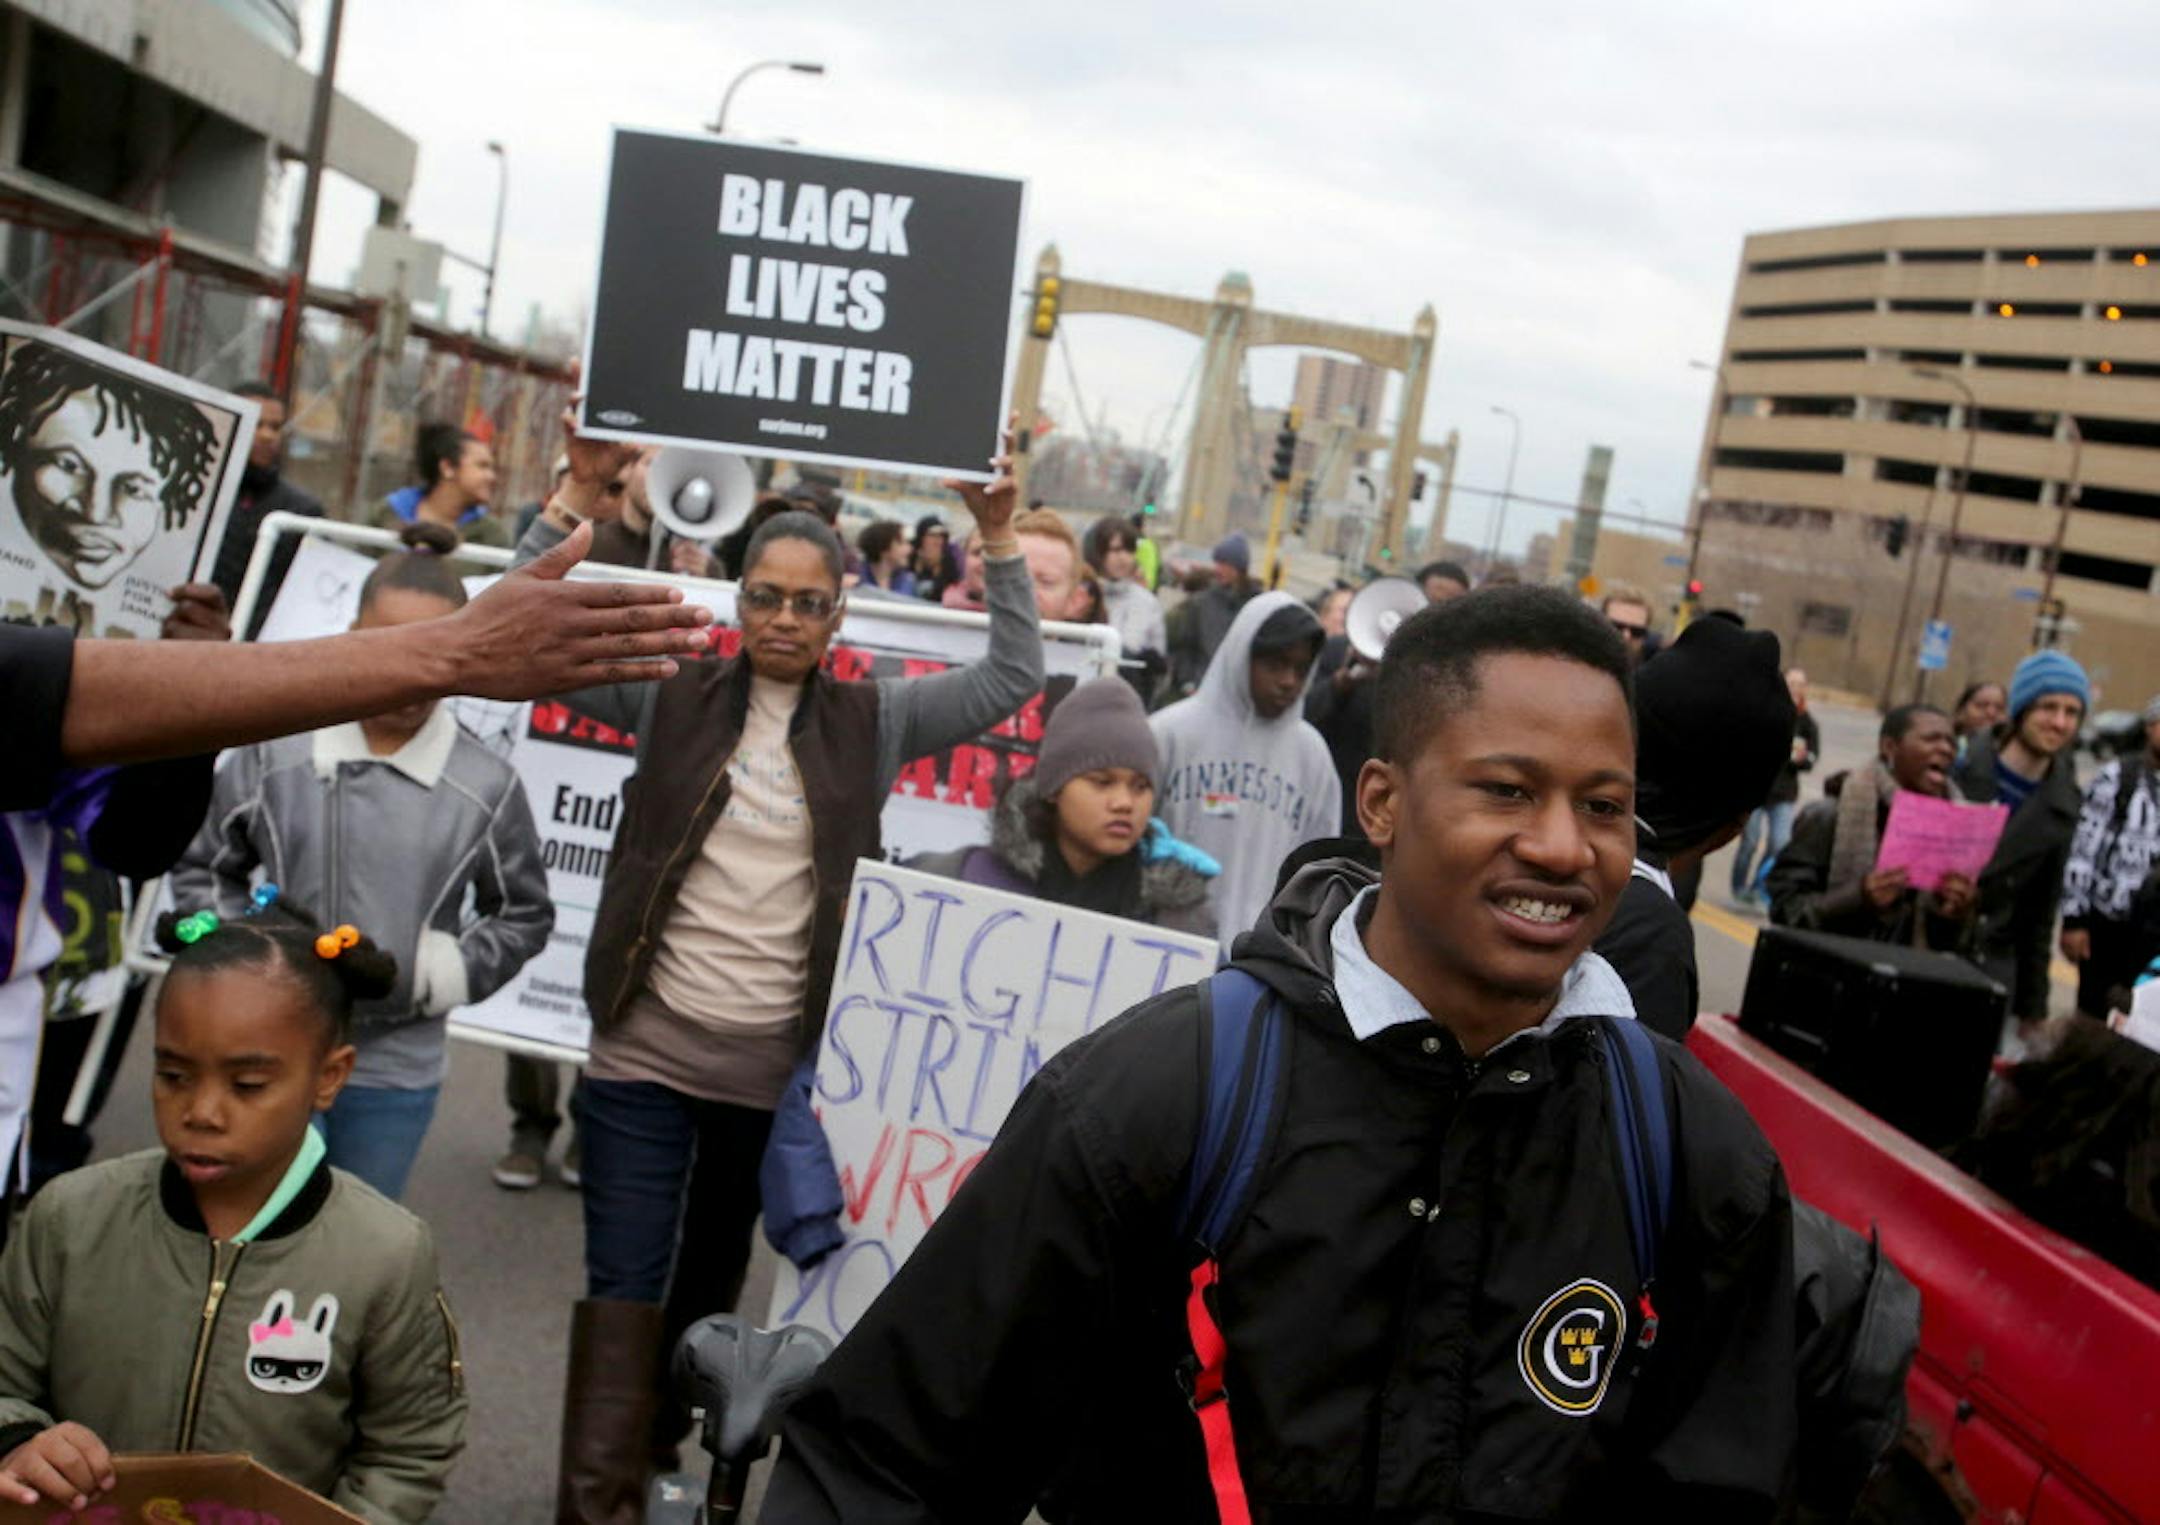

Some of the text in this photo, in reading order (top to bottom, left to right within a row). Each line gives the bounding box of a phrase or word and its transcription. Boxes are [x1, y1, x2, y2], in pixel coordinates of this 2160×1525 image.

[718, 173, 914, 256] BLACK
[726, 254, 888, 333] LIVES
[683, 328, 914, 415] MATTER
[552, 785, 618, 831] End
[844, 876, 1204, 1038] RIGHT
[1543, 1307, 1606, 1389] G
